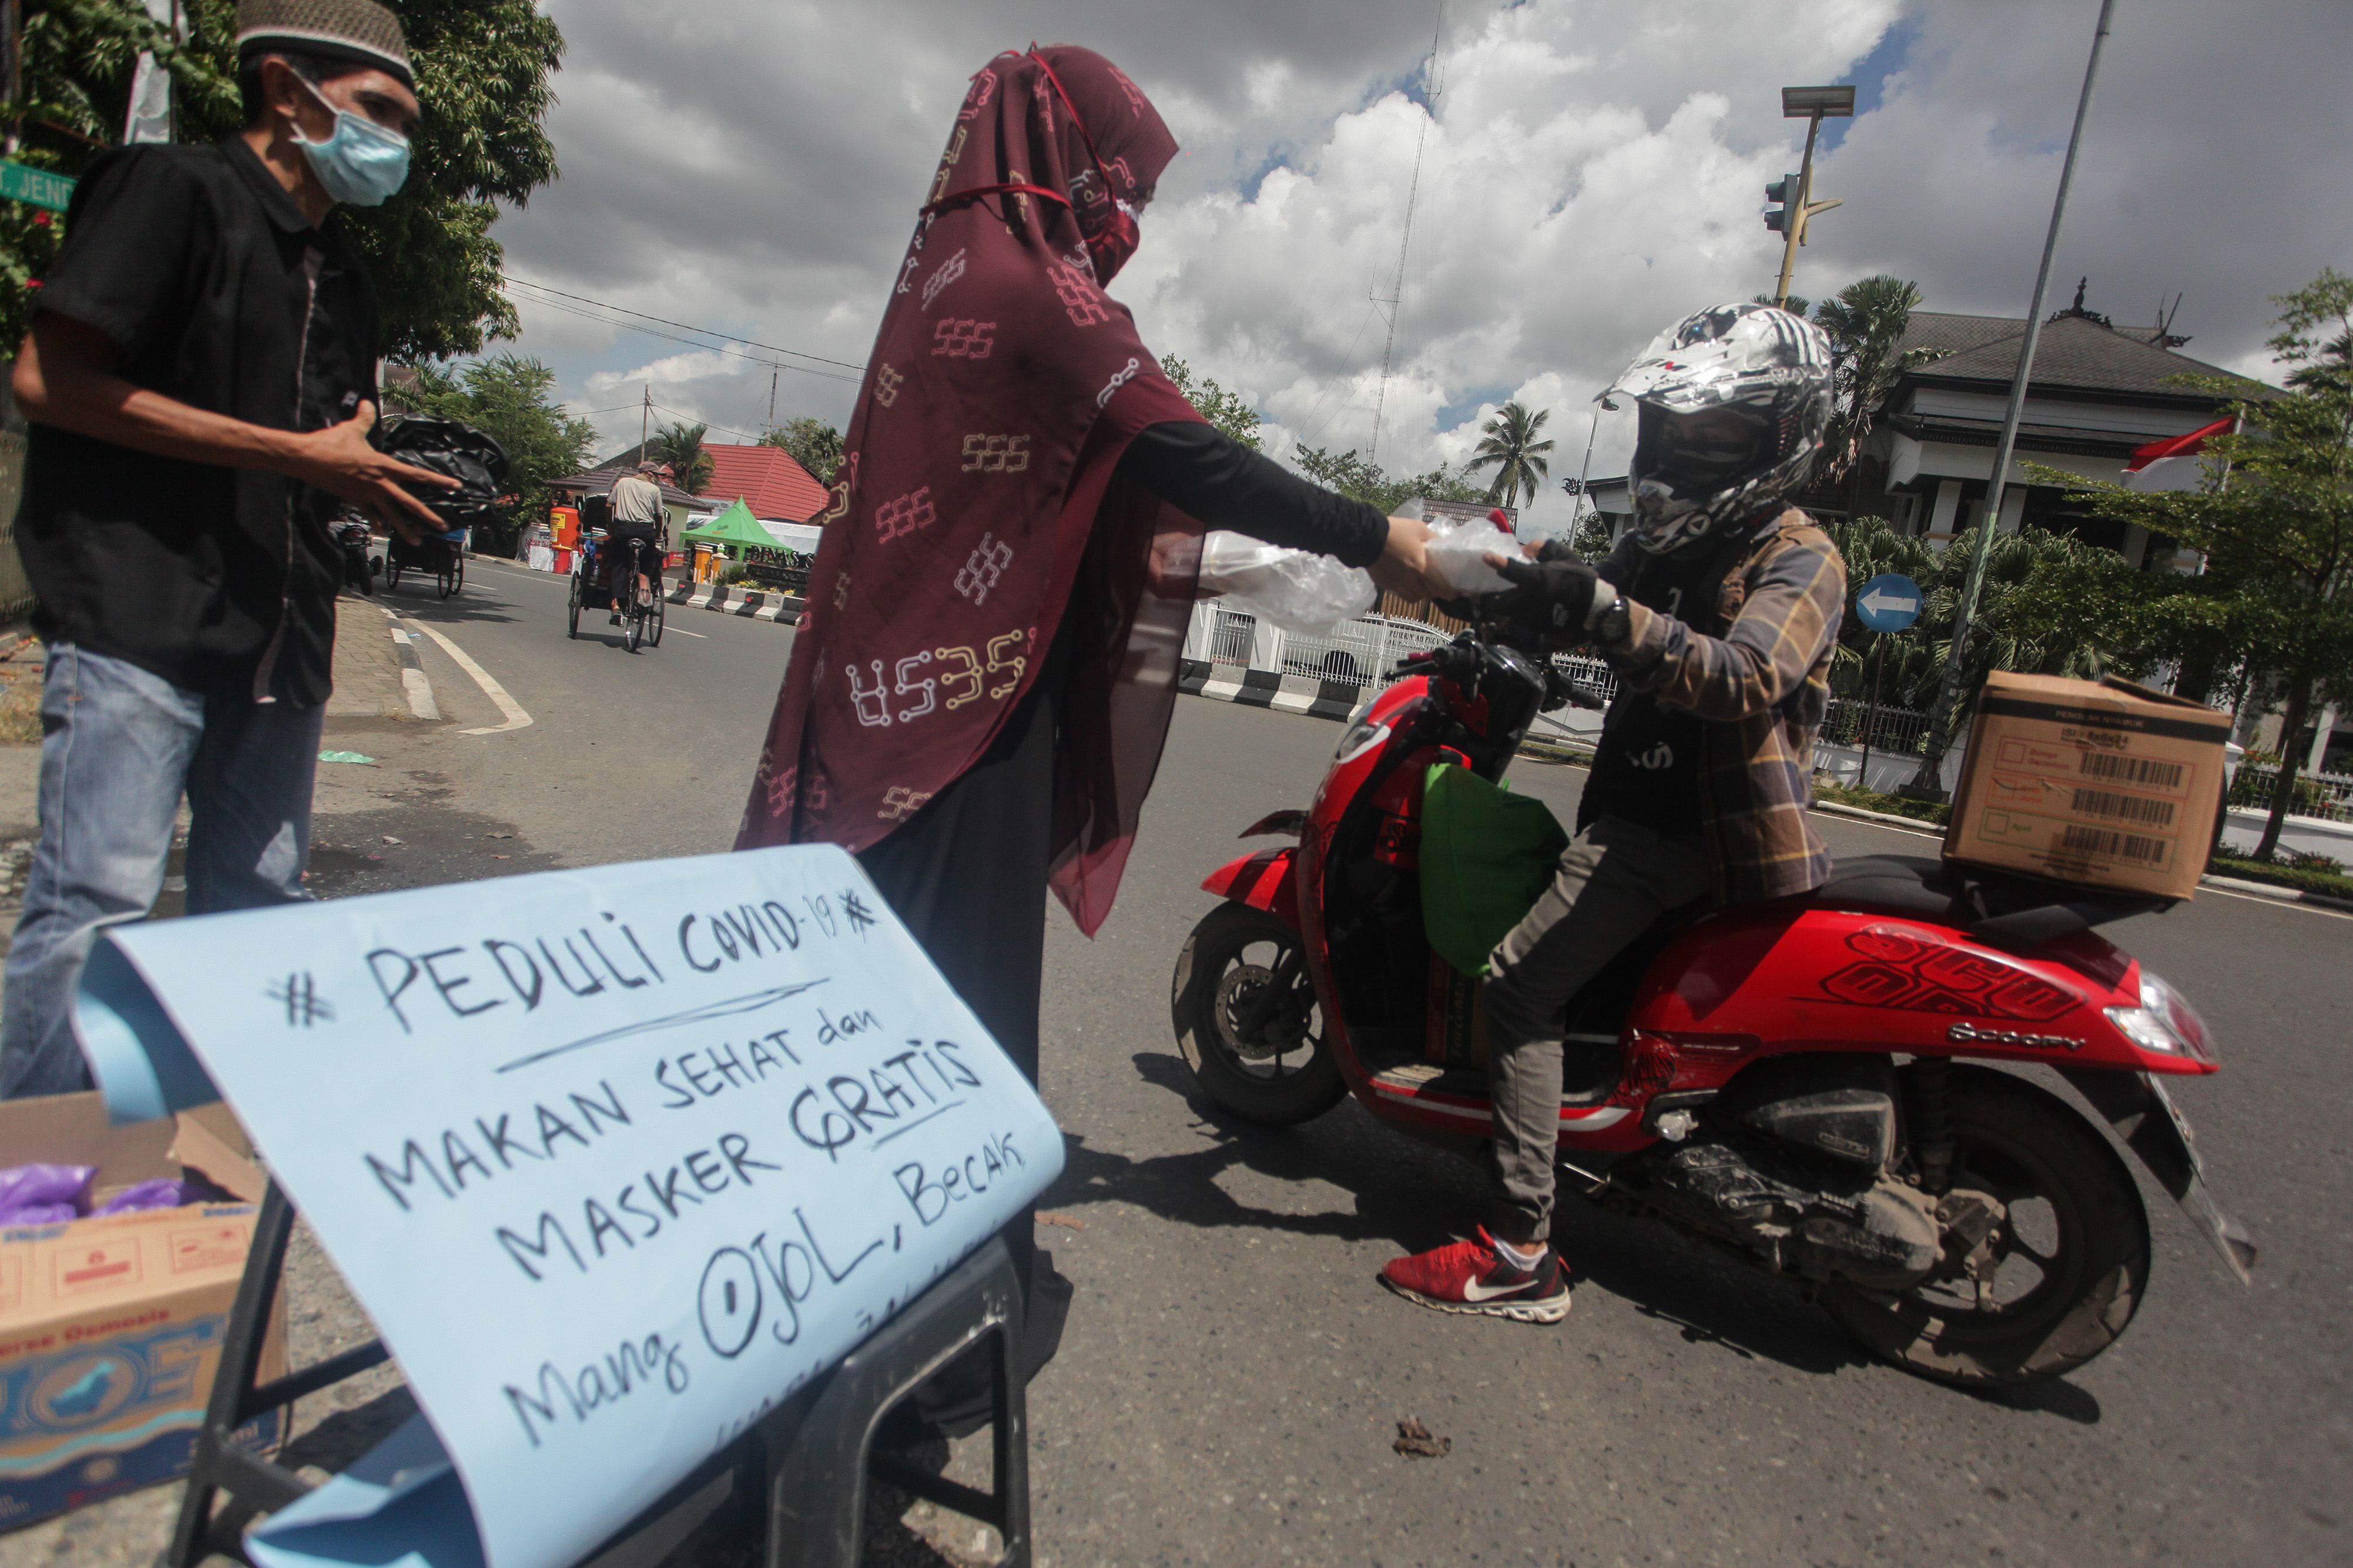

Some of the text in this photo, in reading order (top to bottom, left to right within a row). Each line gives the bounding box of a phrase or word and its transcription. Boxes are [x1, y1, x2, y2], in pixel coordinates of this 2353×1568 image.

[363, 1006, 884, 1211] MAKAN SEHAT dan
[495, 1133, 783, 1282] MASKER
[502, 1332, 689, 1448] Mang
